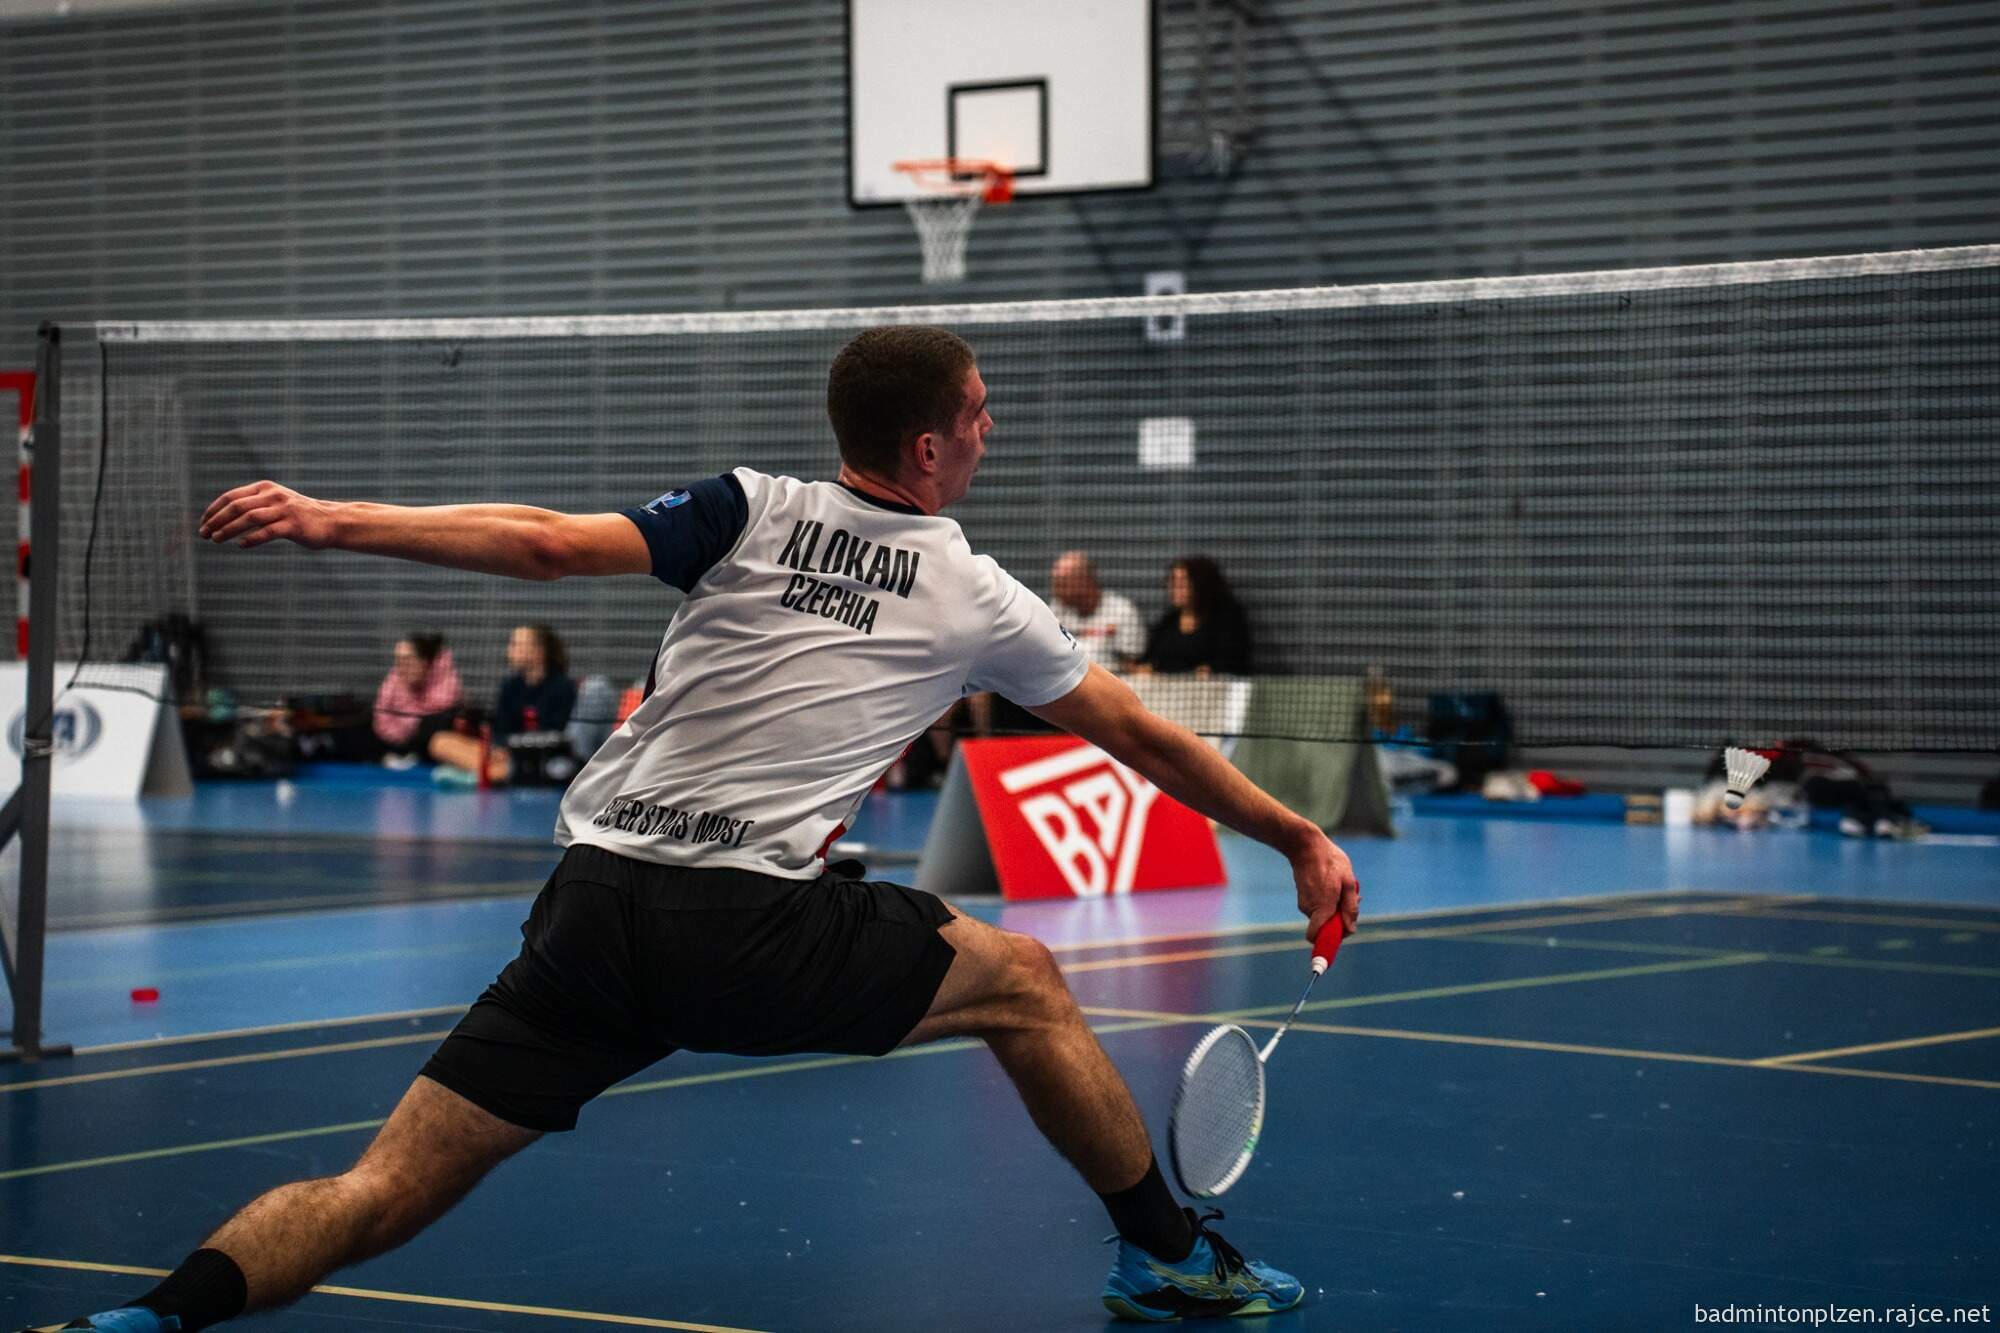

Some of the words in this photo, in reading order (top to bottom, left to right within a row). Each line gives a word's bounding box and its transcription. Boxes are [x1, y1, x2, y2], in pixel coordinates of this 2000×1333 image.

[777, 520, 920, 599] KLOKAN
[780, 573, 880, 635] CZECHIA
[691, 811, 755, 847] MOST
